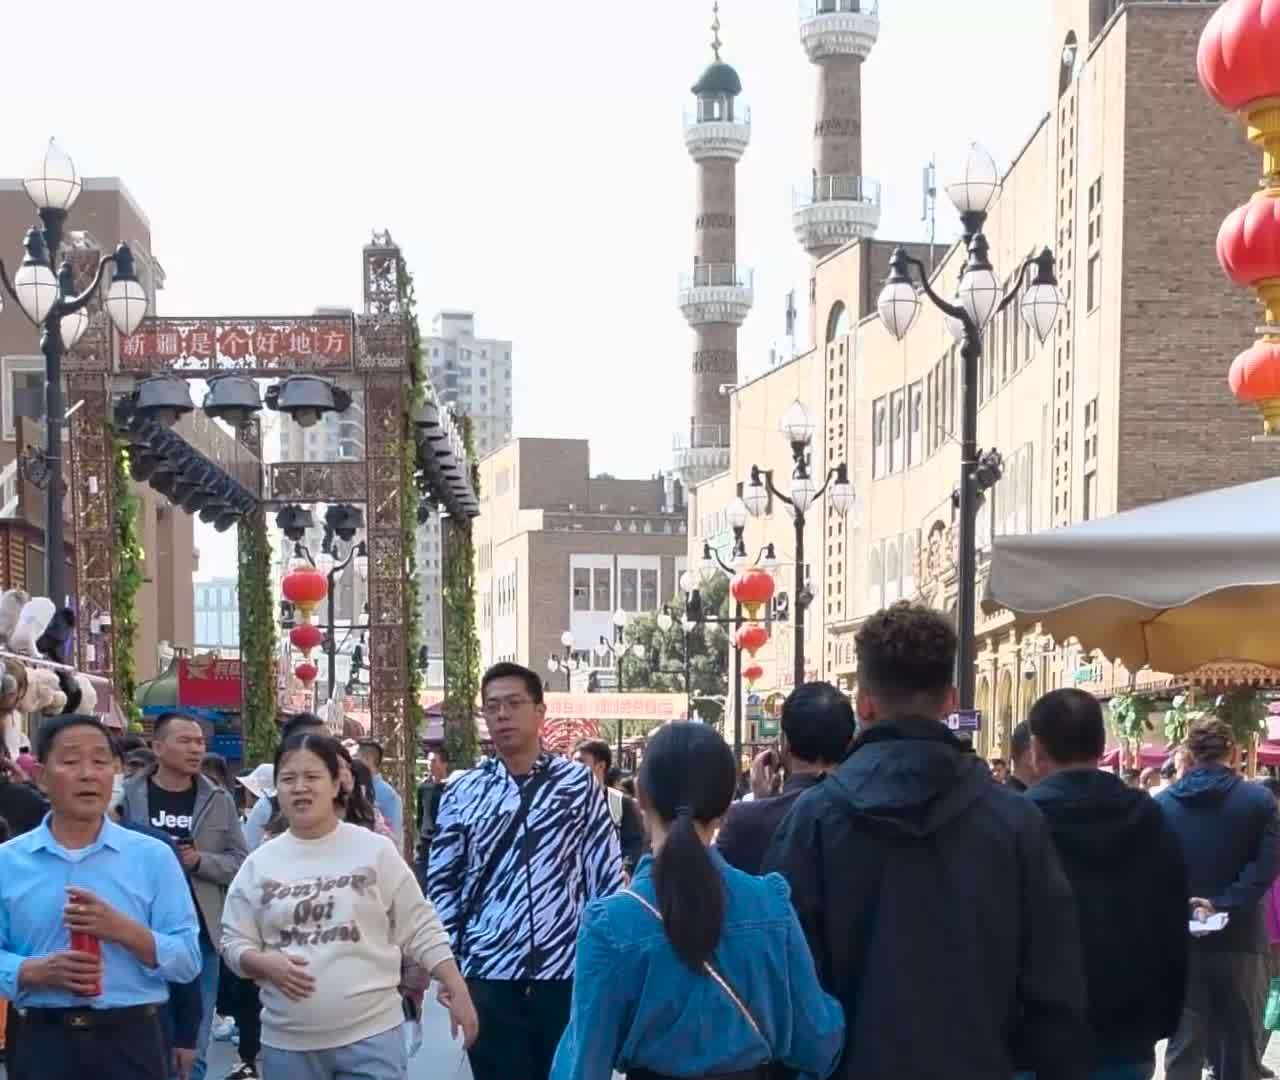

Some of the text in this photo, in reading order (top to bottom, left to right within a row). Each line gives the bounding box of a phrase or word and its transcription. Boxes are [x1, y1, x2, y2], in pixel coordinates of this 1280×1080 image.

[123, 331, 347, 357] 新疆是个好地方
